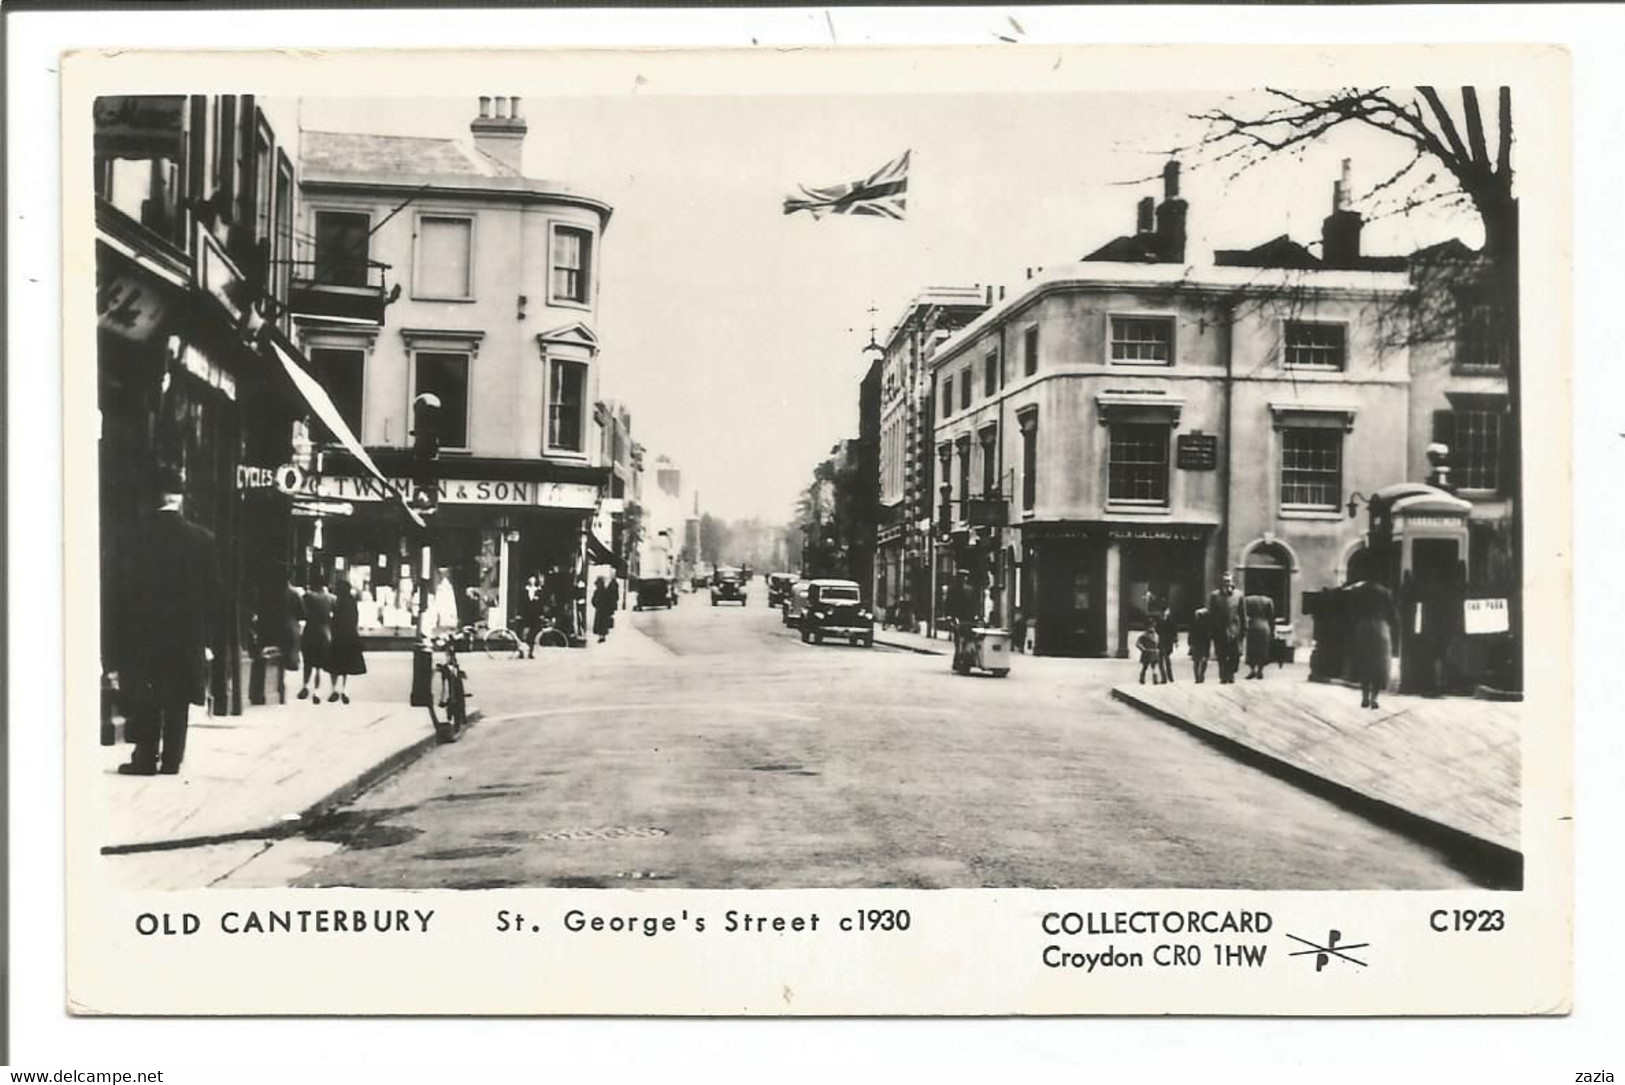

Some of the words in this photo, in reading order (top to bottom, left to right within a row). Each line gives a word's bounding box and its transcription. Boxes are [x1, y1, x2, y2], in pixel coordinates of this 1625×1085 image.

[237, 464, 273, 489] CYCLES
[333, 476, 447, 498] TWYMN
[456, 485, 467, 500] &
[476, 482, 527, 501] SON
